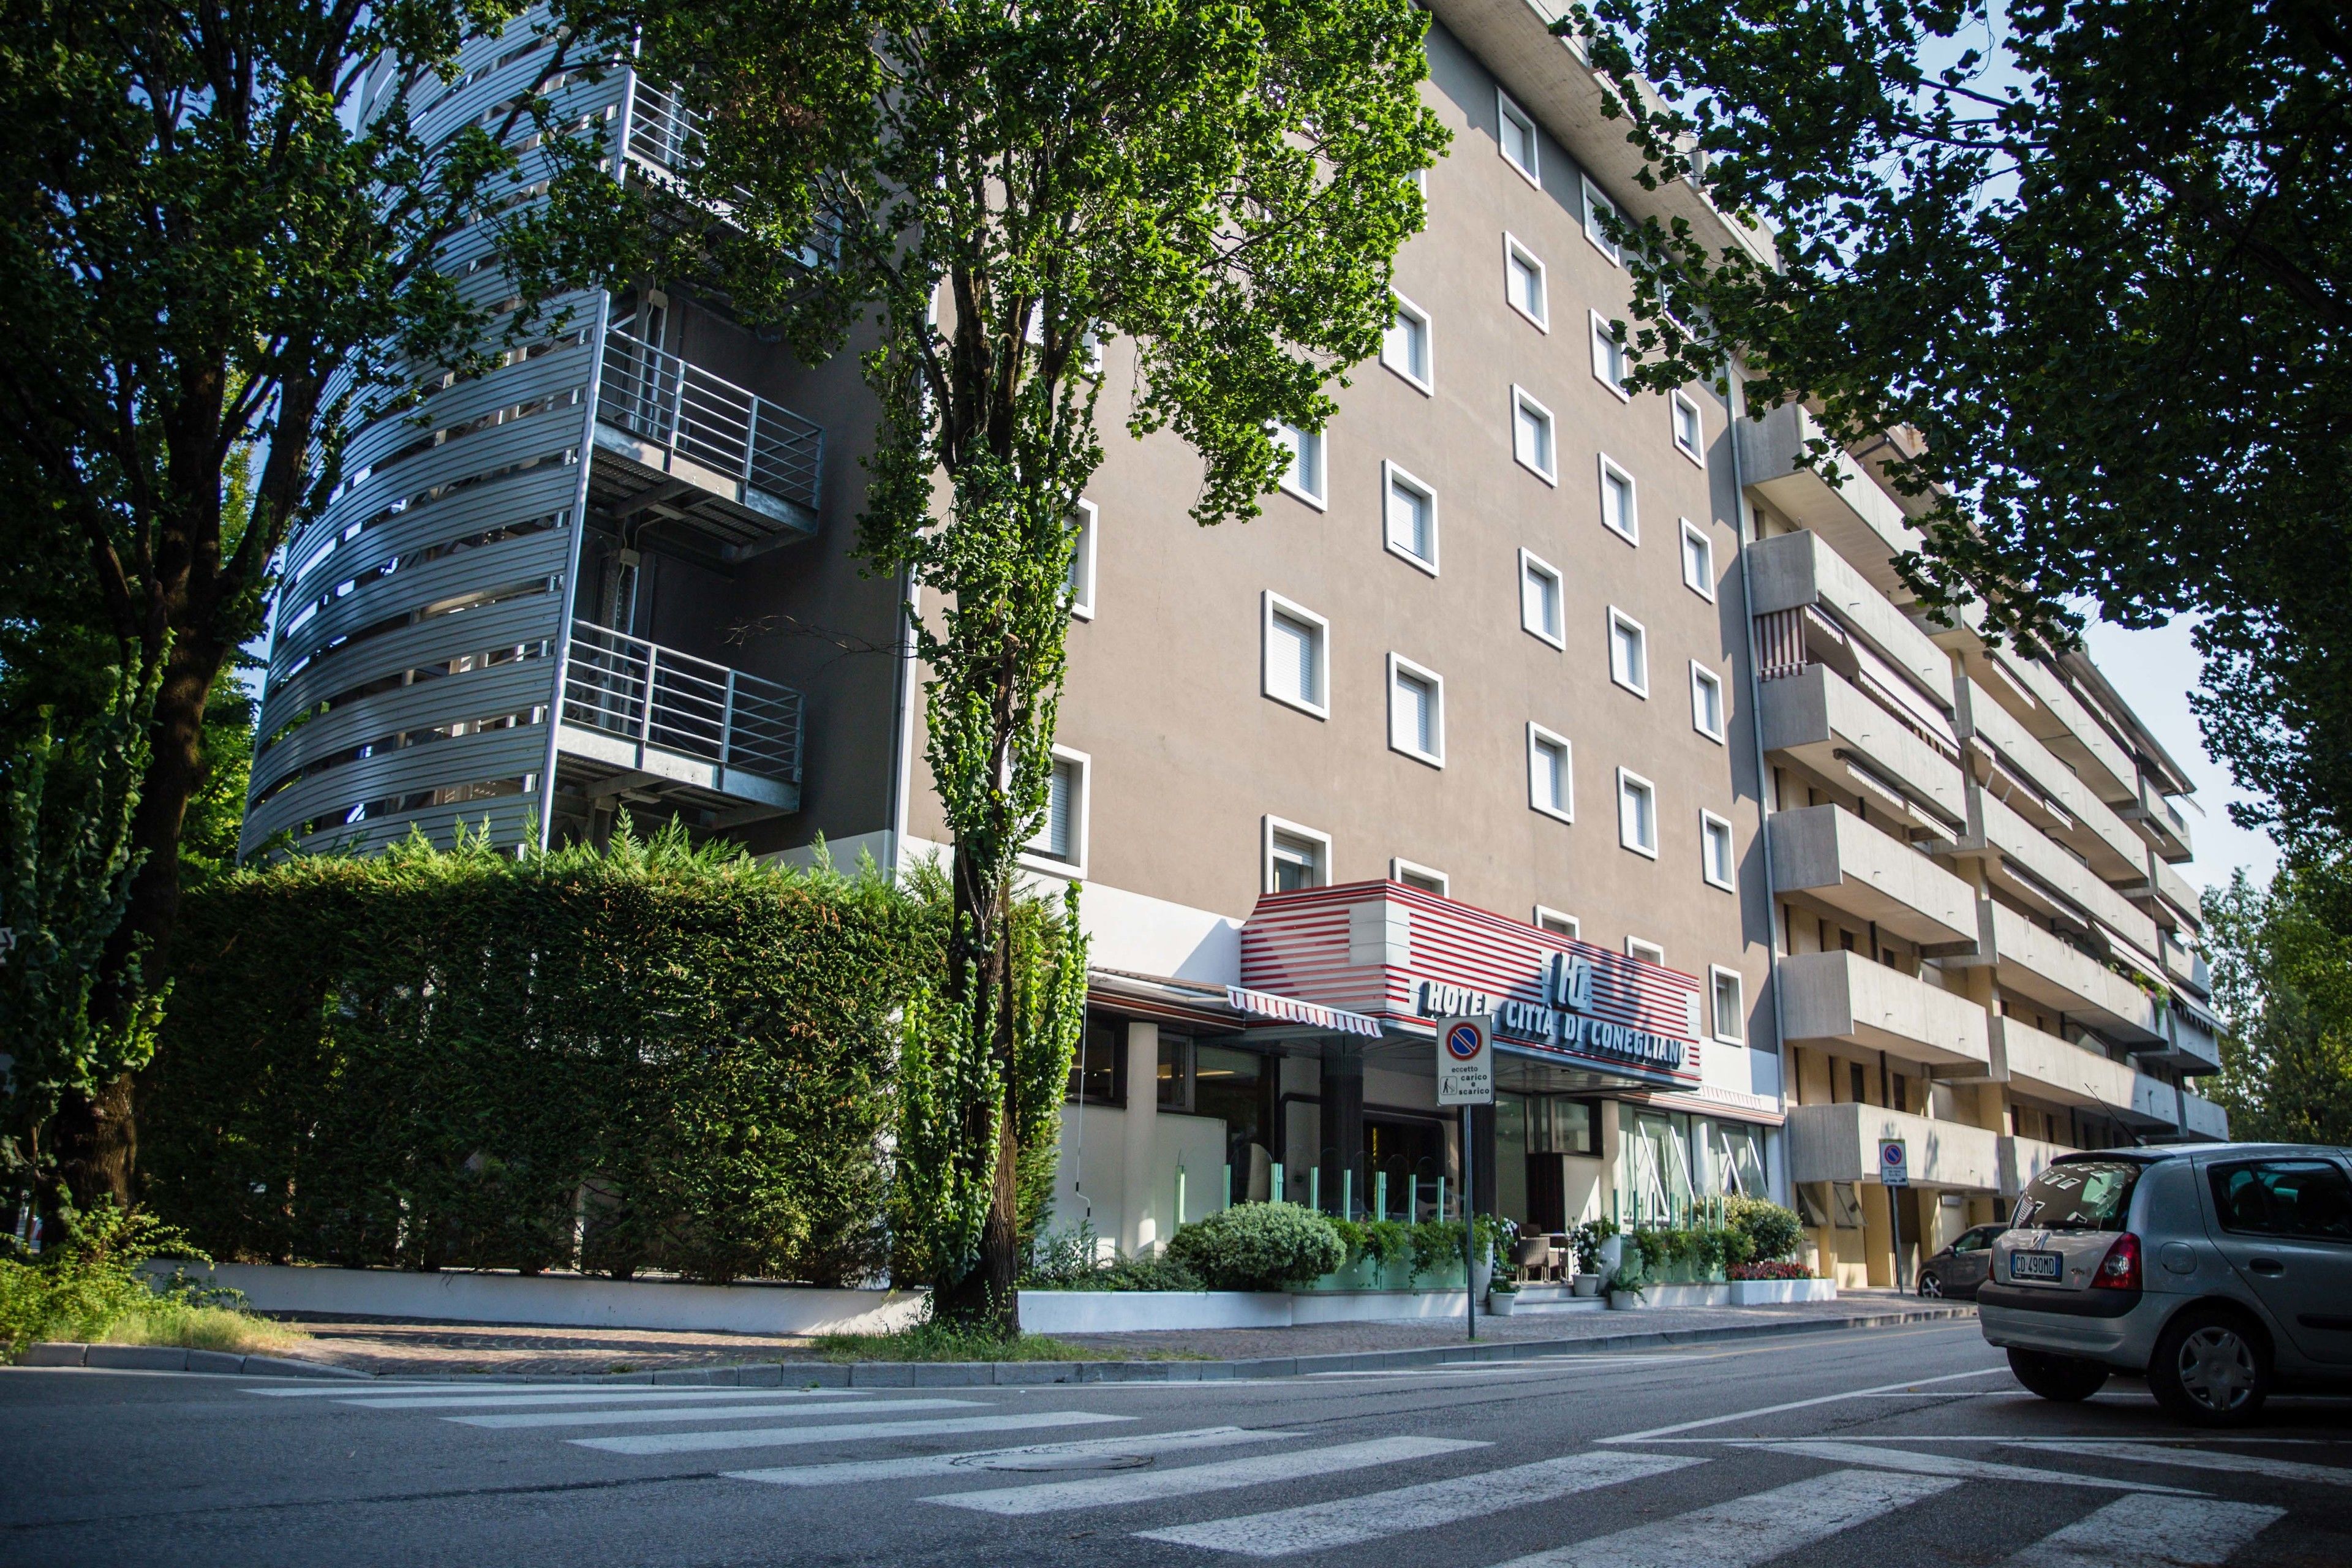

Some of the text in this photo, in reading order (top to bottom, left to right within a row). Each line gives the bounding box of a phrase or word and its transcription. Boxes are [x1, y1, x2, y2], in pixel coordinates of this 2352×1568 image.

[1427, 981, 1689, 1066] HOTEL CITTÀ DI CONEGLIANO
